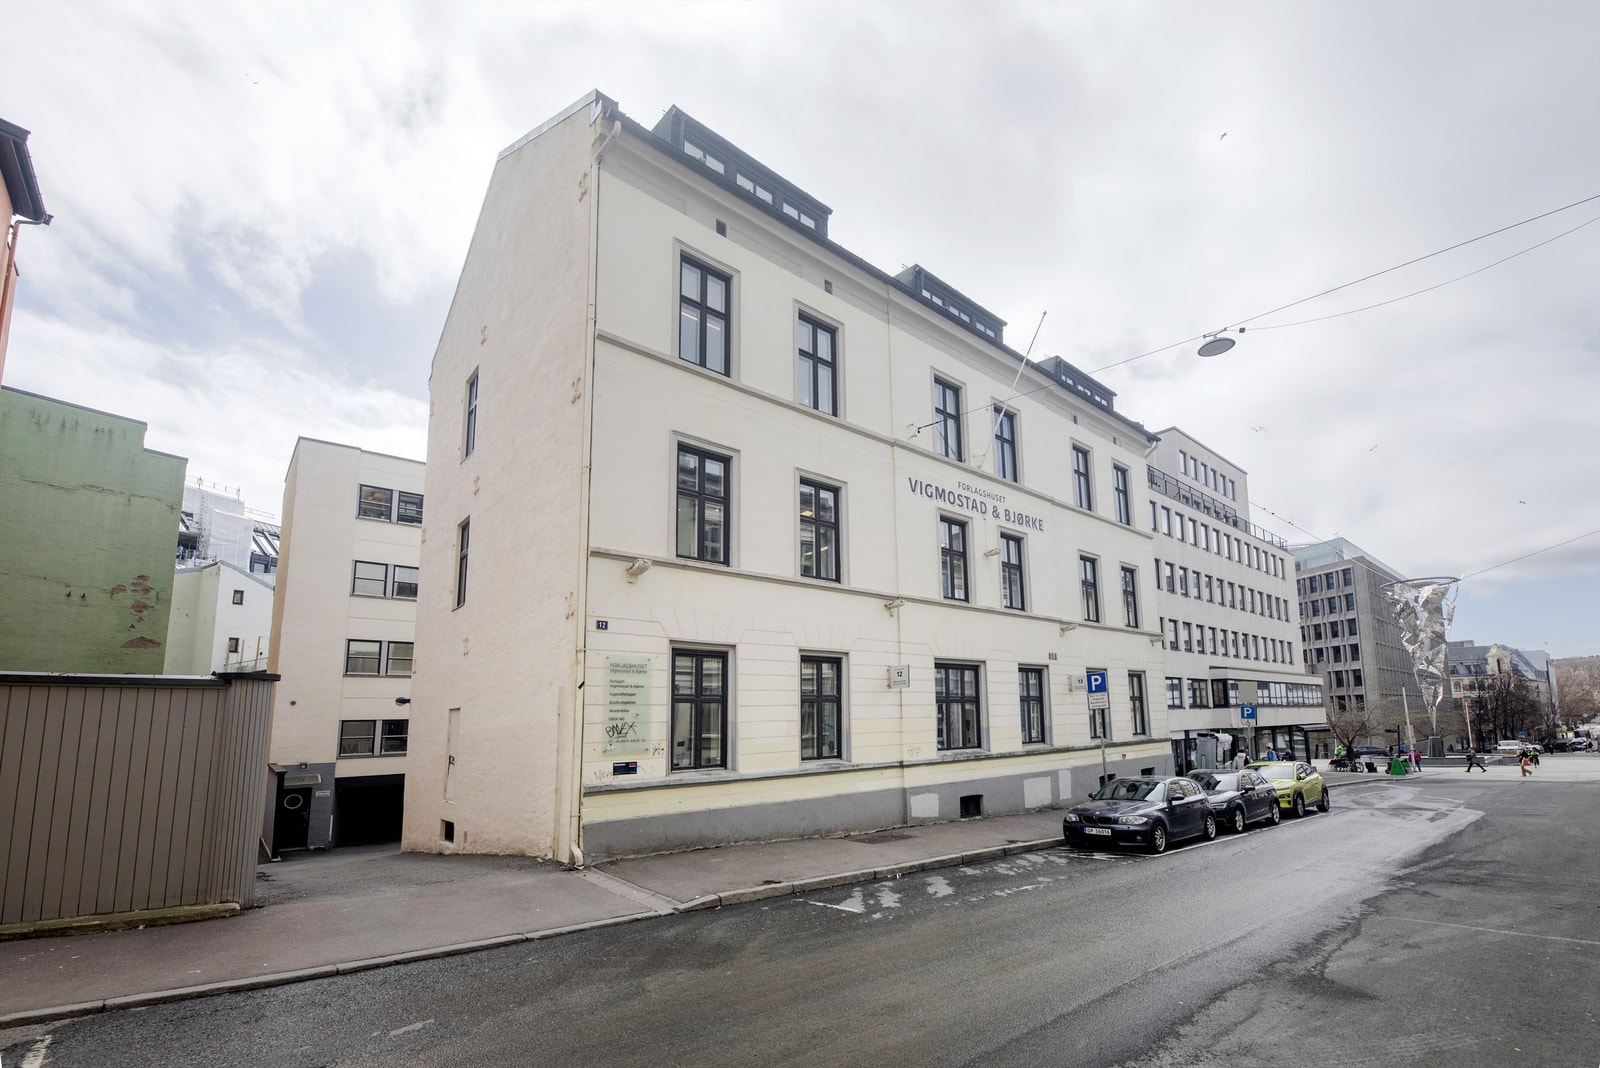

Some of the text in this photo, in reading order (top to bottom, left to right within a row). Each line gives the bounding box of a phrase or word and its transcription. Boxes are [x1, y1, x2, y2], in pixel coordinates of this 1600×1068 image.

[957, 481, 1006, 503] FORLAGSHUSET
[908, 477, 1044, 532] VIGMOSTAD & BJØRKE
[1091, 675, 1101, 691] P
[1244, 708, 1252, 717] P
